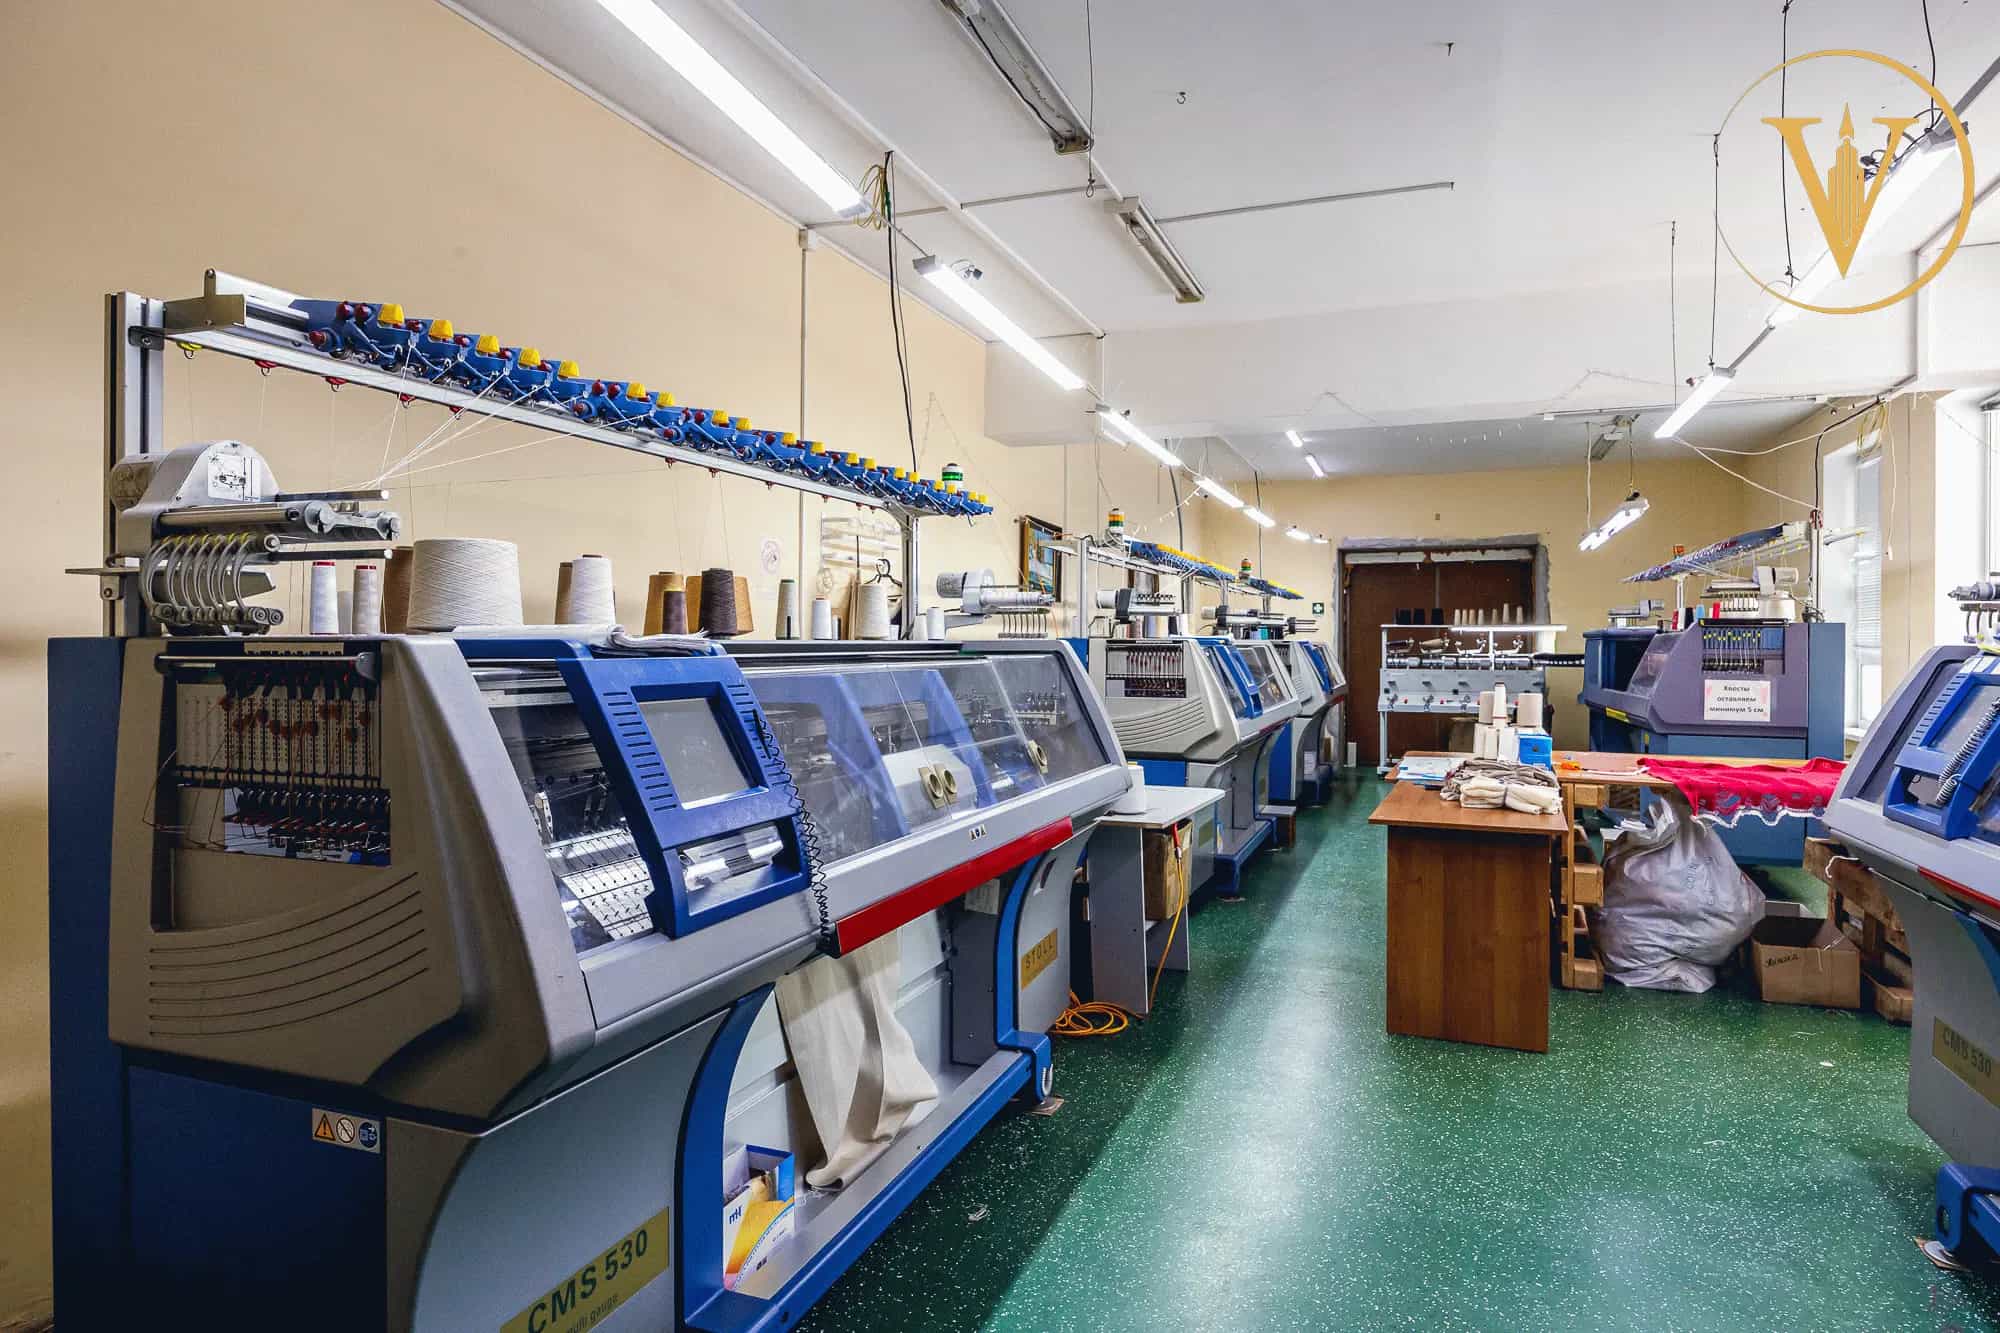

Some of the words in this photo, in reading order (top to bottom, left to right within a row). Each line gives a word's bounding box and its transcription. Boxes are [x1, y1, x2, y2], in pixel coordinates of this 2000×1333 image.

[1943, 1026, 1969, 1060] CMS
[528, 1265, 598, 1333] CMS
[604, 1229, 648, 1281] 530
